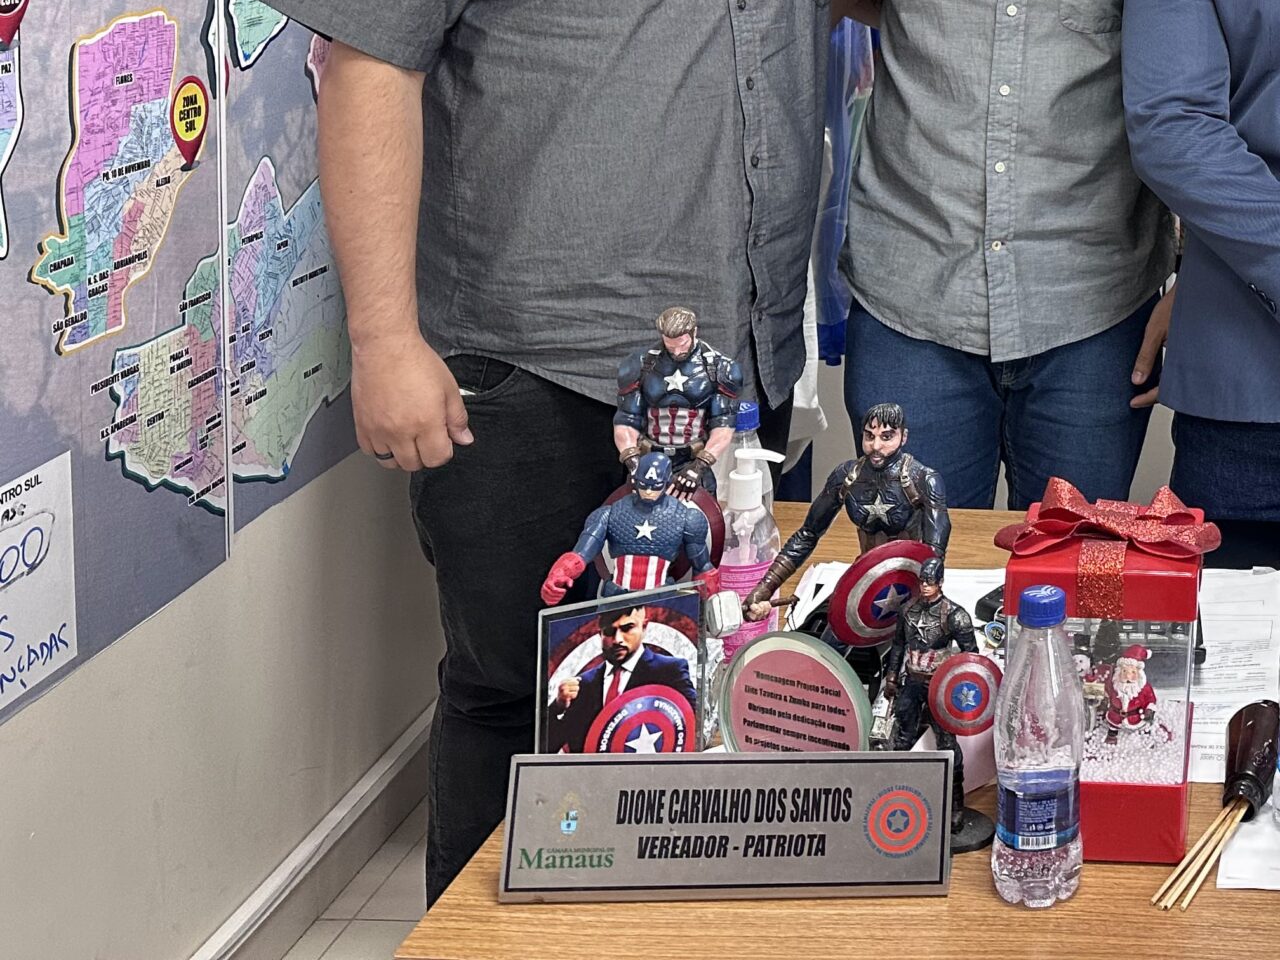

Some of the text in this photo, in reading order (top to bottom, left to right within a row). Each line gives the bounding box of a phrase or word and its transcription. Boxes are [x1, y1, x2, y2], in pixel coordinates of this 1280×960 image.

[1, 65, 12, 74] PAZ
[115, 73, 133, 85] FLORES
[182, 94, 198, 108] ZONA
[178, 105, 202, 122] CENTRO
[184, 120, 197, 133] SUL
[124, 159, 151, 175] NOVEMBRO
[49, 256, 75, 273] CHAPADA
[113, 251, 148, 271] ADRIANÓPOLIS
[99, 270, 109, 281] DAS
[88, 283, 109, 298] GRAÇAS
[53, 311, 87, 334] SÃO GERALDO
[90, 363, 139, 394] PRESIDENTE VARGAS
[111, 413, 137, 434] APARECIDA
[147, 411, 164, 427] CENTRO
[645, 467, 658, 480] A
[0, 474, 42, 505] NTRO SUL
[820, 685, 841, 698] Social
[789, 695, 810, 708] Zumba
[811, 702, 826, 712] para
[777, 710, 845, 733] pela dedicação como
[743, 718, 850, 751] Parlamentar sempre incentivando
[745, 735, 780, 751] Os projetos
[616, 787, 853, 826] DIONE CARVALHO DOS SANTOS
[637, 835, 730, 860] VEREADOR
[742, 833, 827, 858] PATRIOTA
[518, 848, 615, 870] Manaus
